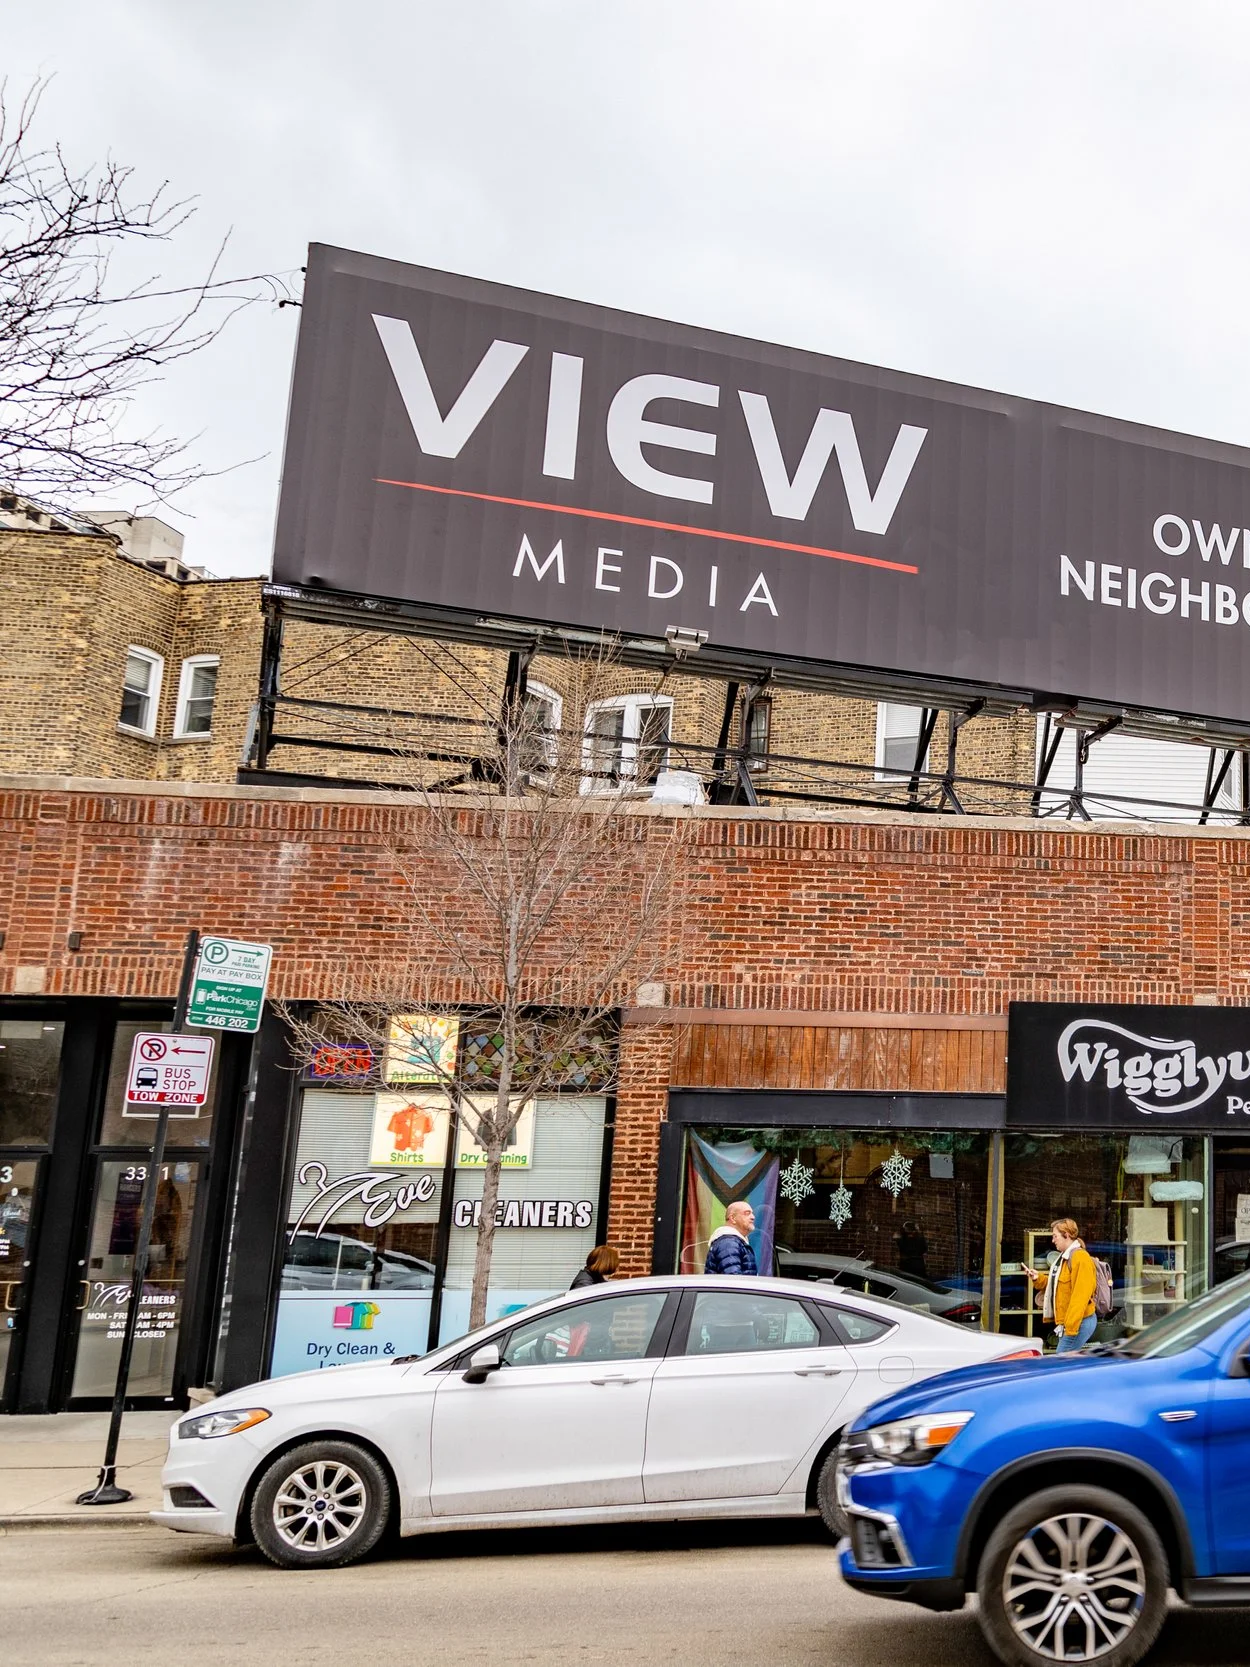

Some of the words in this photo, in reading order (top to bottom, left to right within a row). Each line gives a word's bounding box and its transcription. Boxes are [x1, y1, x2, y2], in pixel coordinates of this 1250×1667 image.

[371, 313, 928, 535] VIEW
[513, 533, 779, 616] MEDIA
[243, 956, 256, 964] DAY
[201, 966, 217, 975] PAY
[229, 970, 244, 979] PAY
[245, 973, 263, 981] BOX
[206, 992, 258, 1008] ParkChicago
[205, 1015, 226, 1026] 446
[227, 1018, 249, 1029] 202
[314, 1046, 372, 1076] OPEN
[165, 1067, 191, 1079] BUS
[391, 1071, 454, 1082] Alterat
[163, 1079, 196, 1091] STOP
[132, 1091, 159, 1101] TOW
[164, 1093, 199, 1103] ZONE
[390, 1152, 424, 1163] Shirts
[460, 1153, 479, 1164] Dry
[482, 1153, 527, 1164] Caning
[125, 1166, 169, 1181] 331
[139, 1295, 176, 1305] EANERS
[87, 1312, 107, 1320] MON
[112, 1312, 128, 1320] FRI
[109, 1321, 127, 1329] SAT
[136, 1321, 151, 1329] AM
[307, 1342, 332, 1358] Dry
[336, 1342, 378, 1355] Clean
[383, 1342, 396, 1355] &
